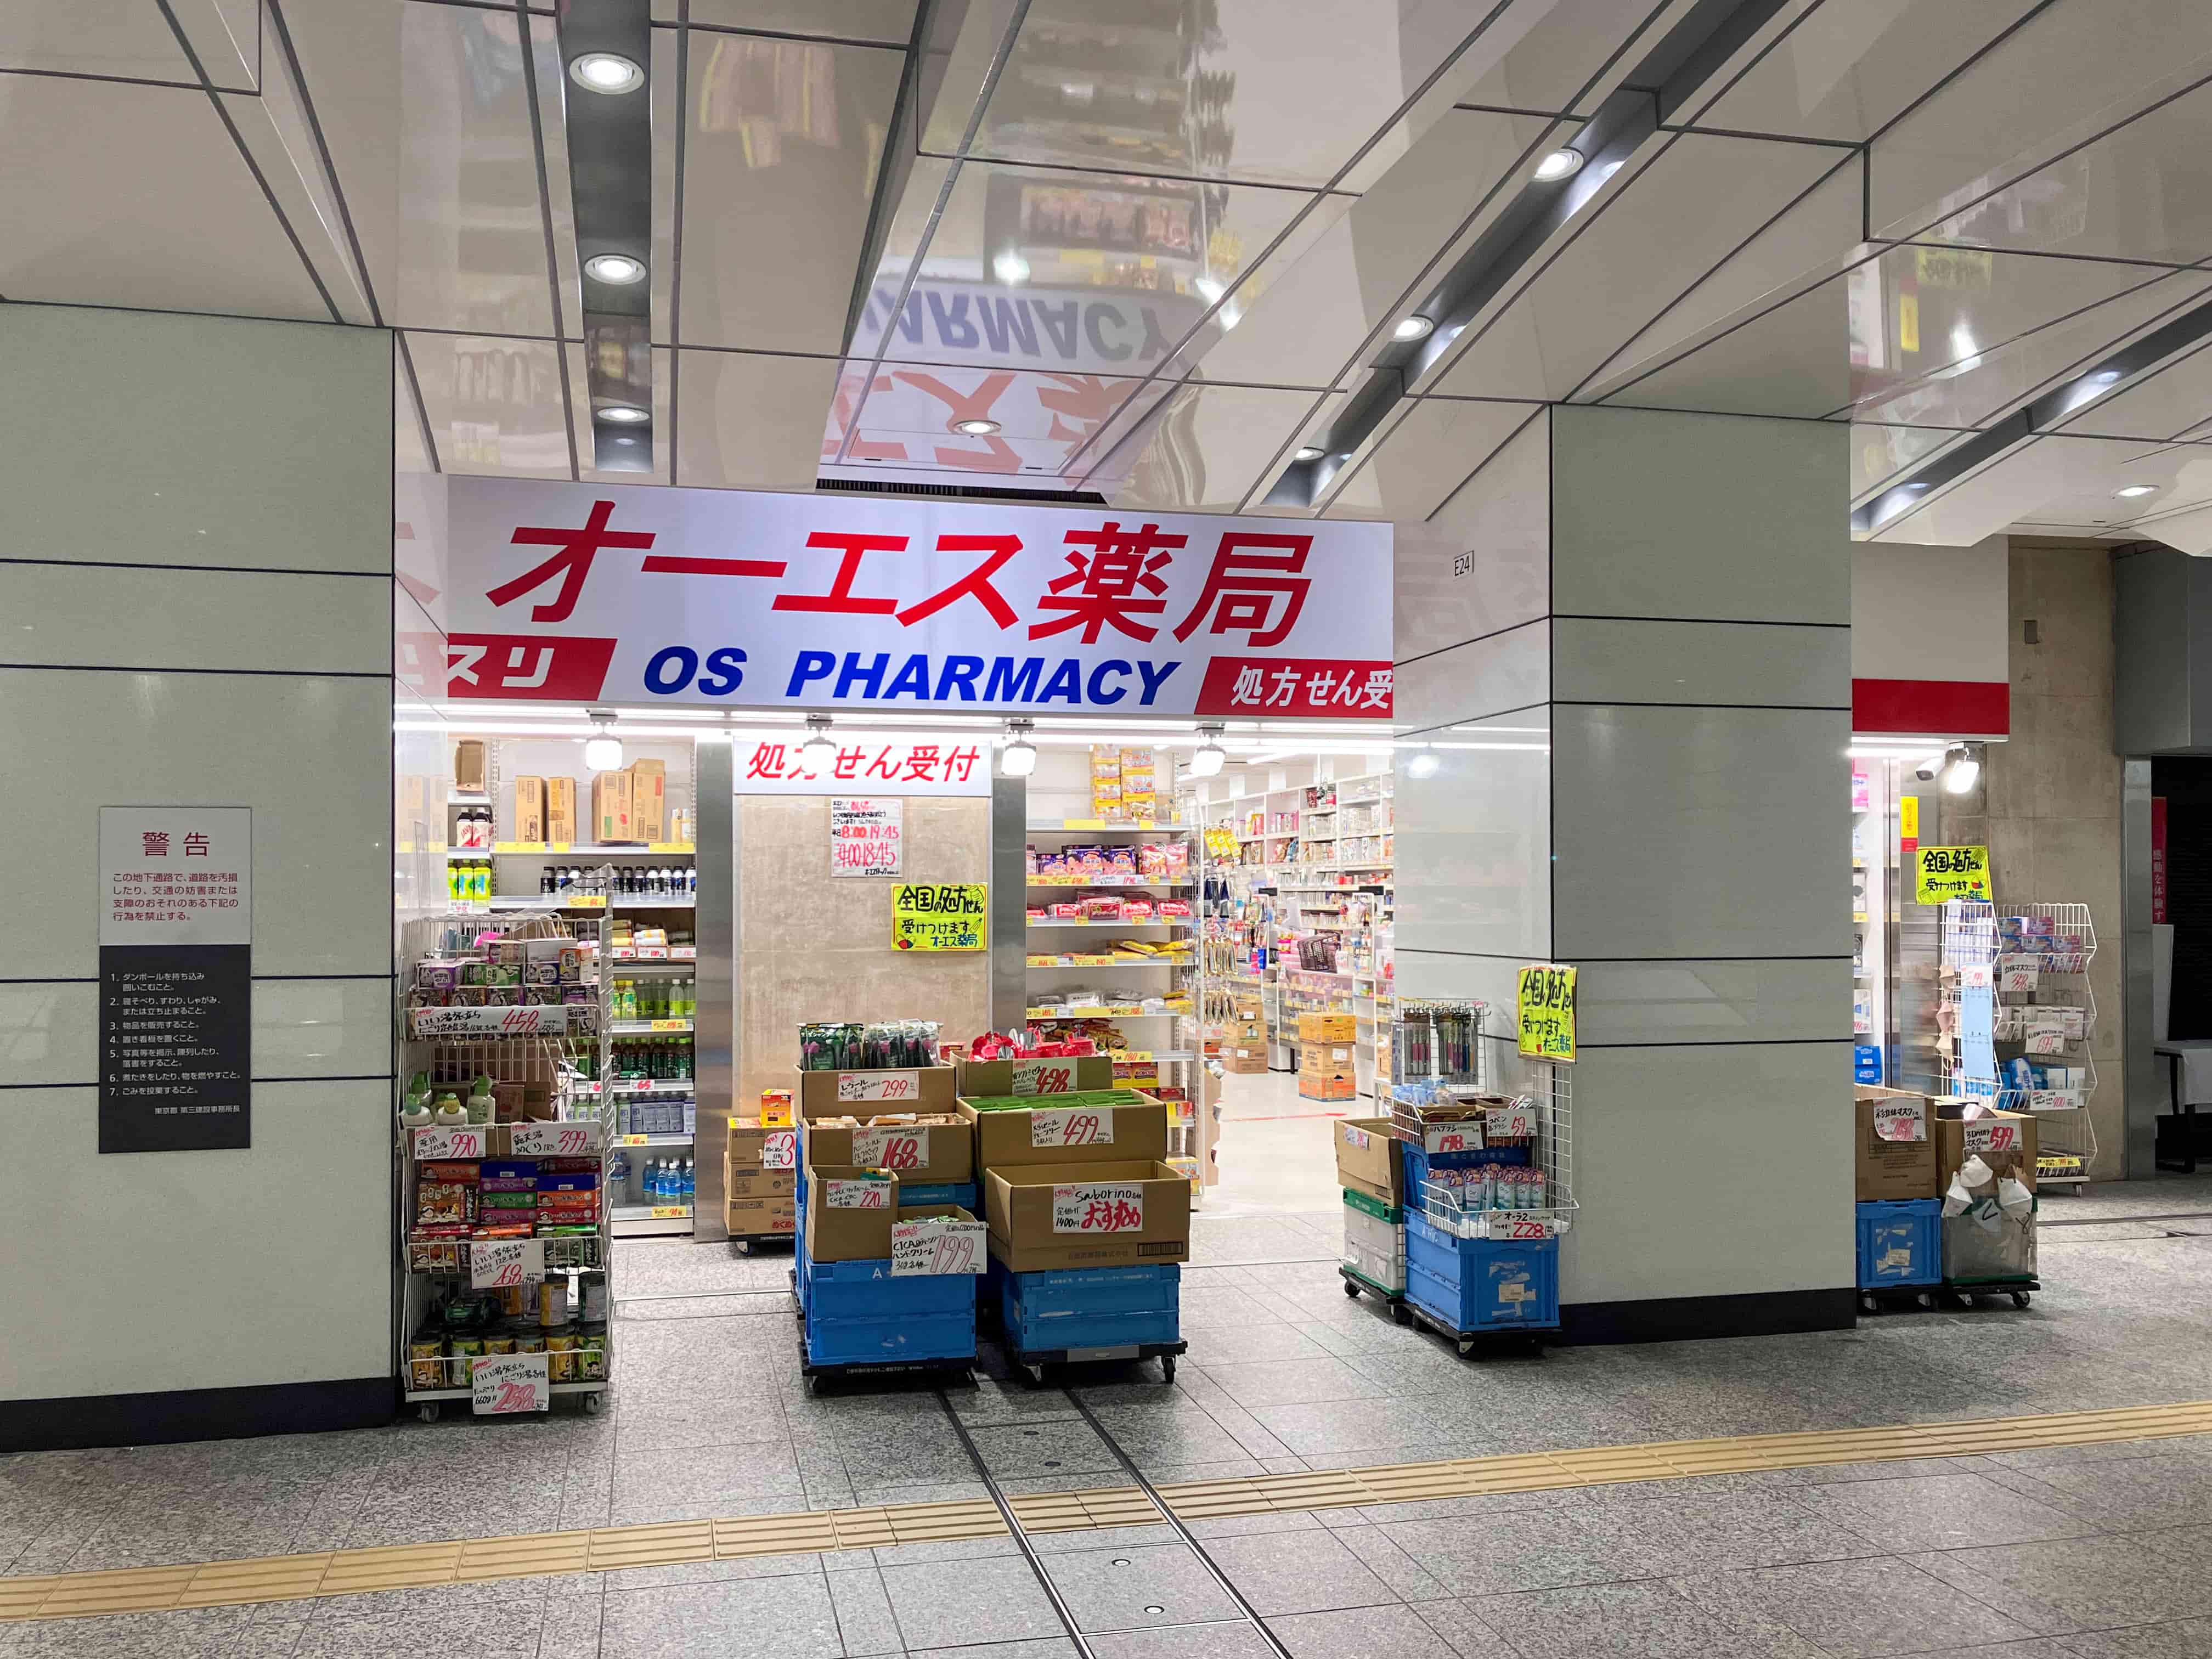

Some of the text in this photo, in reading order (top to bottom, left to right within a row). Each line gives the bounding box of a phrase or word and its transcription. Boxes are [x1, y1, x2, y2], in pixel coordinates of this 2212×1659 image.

[486, 500, 1313, 647] オーエス薬局
[1454, 554, 1470, 577] E24
[644, 645, 1181, 706] OS PHARMACY
[1231, 665, 1392, 709] 処方せん受
[142, 832, 210, 856] 警告
[1923, 848, 1982, 872] 全国の処方せん
[113, 873, 238, 883] この地下通路で、道路を汚損
[1926, 878, 1968, 891] 受けつけます
[113, 886, 238, 895] したり、交通の妨害または
[897, 885, 983, 913] 全国の処方せん
[113, 899, 238, 909] 支障のおそれのある下記の
[113, 912, 191, 921] 行為を禁止する。
[902, 919, 969, 934] 受けつけます
[930, 934, 978, 947] オーエス薬局
[111, 973, 205, 981] 1. ダンボールを持ち込み
[122, 1007, 206, 1015] または立ち止まること。
[122, 1020, 199, 1030] 物品を販売すること。
[501, 1009, 539, 1032] 458
[110, 1036, 119, 1044] 4.
[110, 1049, 119, 1058] 5.
[110, 1074, 119, 1082] 6.
[1036, 1067, 1070, 1094] 498
[110, 1088, 119, 1096] 7.
[882, 1080, 908, 1097] 299
[1063, 1115, 1099, 1145] 499
[1511, 1116, 1526, 1136] 59
[450, 1134, 477, 1158] 990
[558, 1130, 586, 1153] 399
[881, 1137, 918, 1168] 168
[860, 1190, 880, 1207] 220
[1075, 1189, 1132, 1203] Saborino
[1056, 1218, 1080, 1228] 1400円
[1081, 1199, 1142, 1231] おすすめ
[1513, 1222, 1545, 1239] 228
[930, 1234, 974, 1273] 199
[492, 1263, 522, 1285] 268
